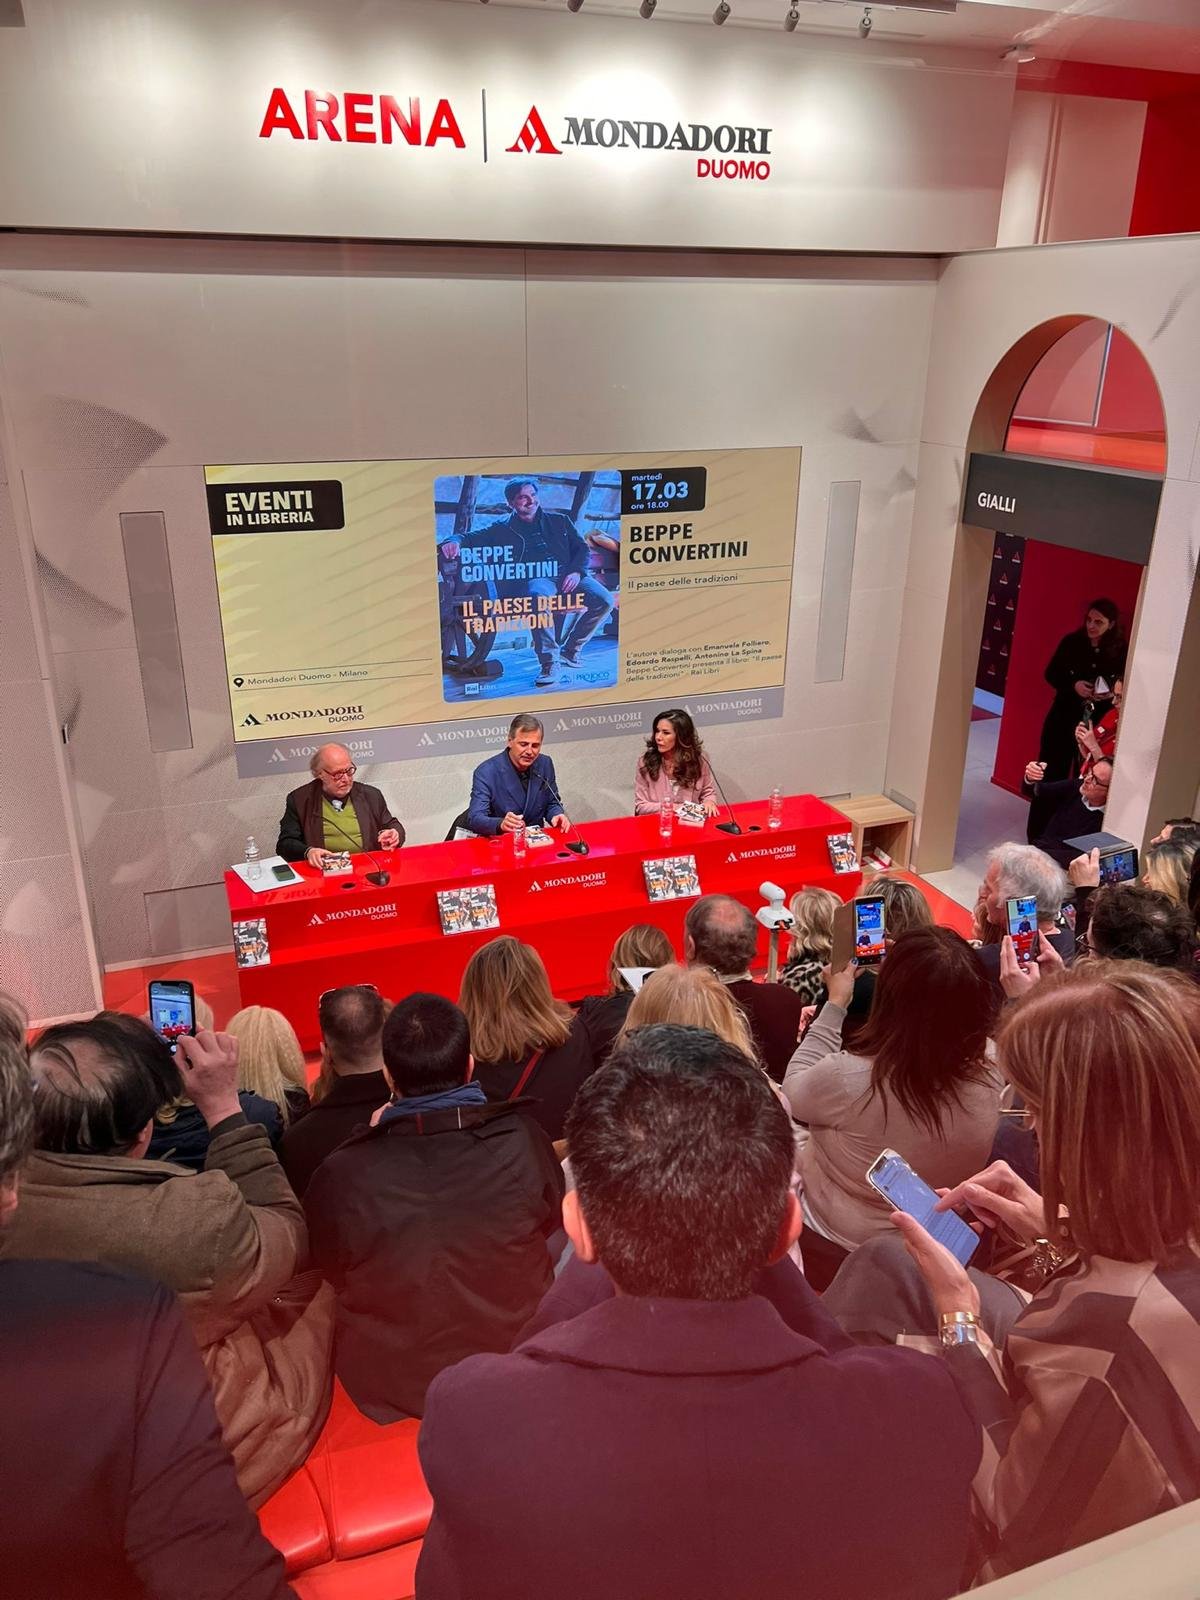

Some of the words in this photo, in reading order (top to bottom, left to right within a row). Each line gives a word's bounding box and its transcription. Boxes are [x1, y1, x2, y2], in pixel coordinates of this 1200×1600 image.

[259, 88, 466, 149] ARENA
[561, 117, 773, 155] MONDADORI
[697, 159, 771, 180] DUOMO
[631, 473, 663, 482] martedì
[632, 481, 689, 500] 17.03
[225, 490, 313, 513] EVENTI
[646, 501, 669, 509] 18.00
[977, 491, 1016, 513] GIALLI
[226, 513, 243, 526] IN
[247, 511, 314, 525] LIBRERIA
[630, 523, 693, 543] BEPPE
[460, 545, 514, 564] BEPPE
[629, 541, 748, 565] CONVERTINI
[461, 561, 559, 583] CONVERTINI
[628, 580, 634, 589] Il
[636, 580, 666, 590] paese
[668, 577, 692, 587] delle
[694, 573, 738, 584] tradizioni
[463, 600, 478, 617] IL
[482, 596, 533, 616] PAESE
[537, 593, 586, 611] DELLE
[463, 612, 555, 635] TRADIZIONI
[626, 650, 658, 659] L'autore
[659, 647, 687, 656] dialoga
[703, 641, 740, 651] Emanuela
[626, 658, 660, 666] Edoardo
[694, 651, 729, 660] Antonino
[741, 648, 762, 656] Spina
[626, 667, 651, 675] Beppe
[652, 662, 691, 672] Convertini
[692, 659, 724, 669] presenta
[761, 654, 783, 662] paese
[247, 675, 297, 686] Mondadori
[299, 672, 332, 681] Duomo
[339, 669, 368, 678] Milano
[626, 675, 645, 683] delle
[263, 705, 364, 722] MONDADORI
[696, 698, 762, 714] MONDADORI
[737, 708, 762, 716] DUOMO
[328, 714, 365, 724] DUOMO
[571, 711, 643, 729] MONDADORI
[615, 720, 643, 730] DUOMO
[437, 726, 509, 741] MONDADOR
[485, 736, 508, 744] DUOM
[739, 844, 797, 860] MONDADORI
[774, 852, 797, 861] DUOMO
[543, 871, 607, 888] MONDADORI
[582, 879, 607, 889] DUOMO
[324, 903, 397, 921] MONDADORI
[370, 911, 398, 921] DUOMO
